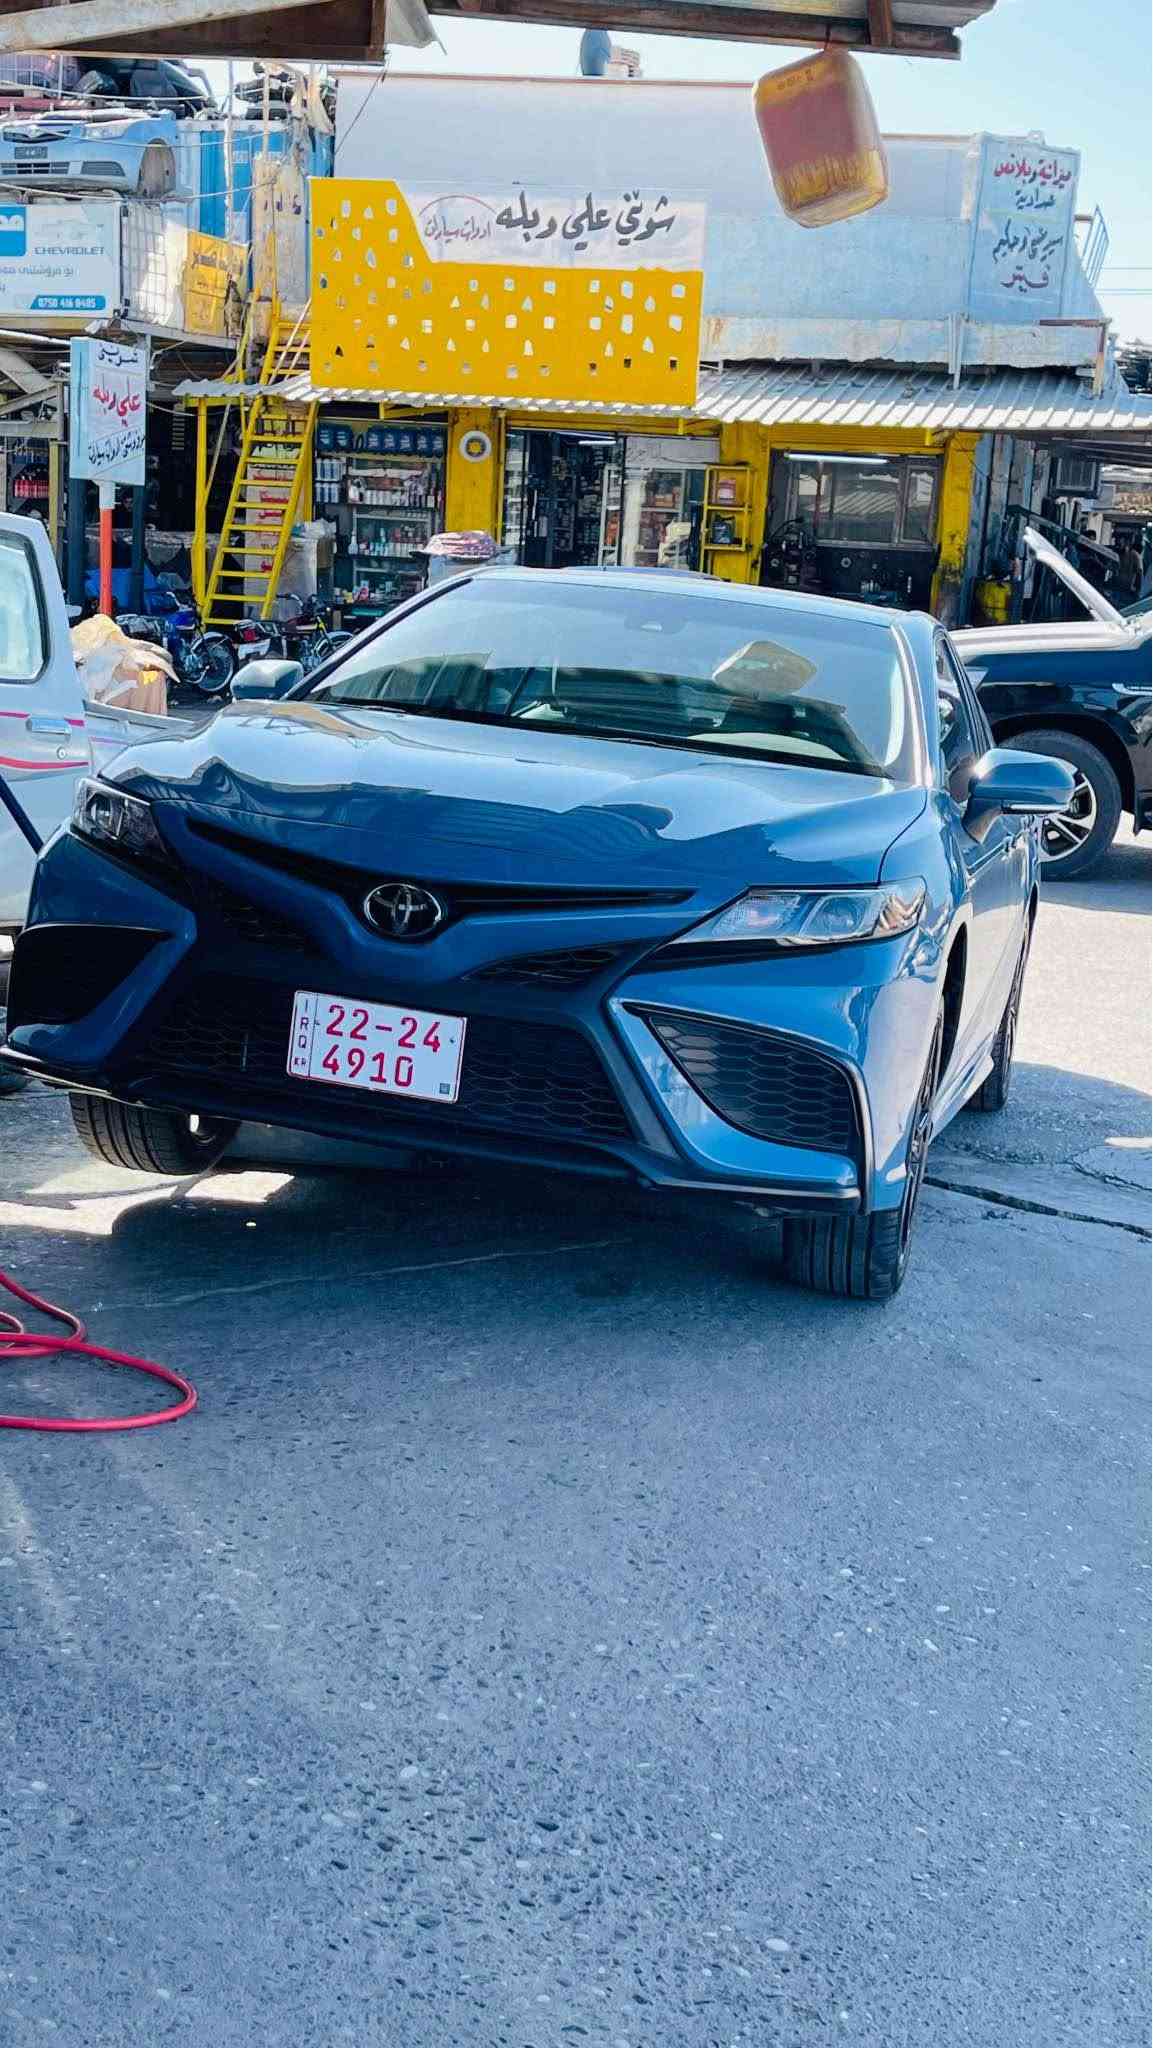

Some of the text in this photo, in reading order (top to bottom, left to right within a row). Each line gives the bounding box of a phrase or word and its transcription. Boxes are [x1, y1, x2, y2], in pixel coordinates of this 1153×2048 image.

[34, 246, 105, 255] CHEVROLET
[326, 1004, 440, 1053] 22-24
[322, 1044, 414, 1087] 4910
